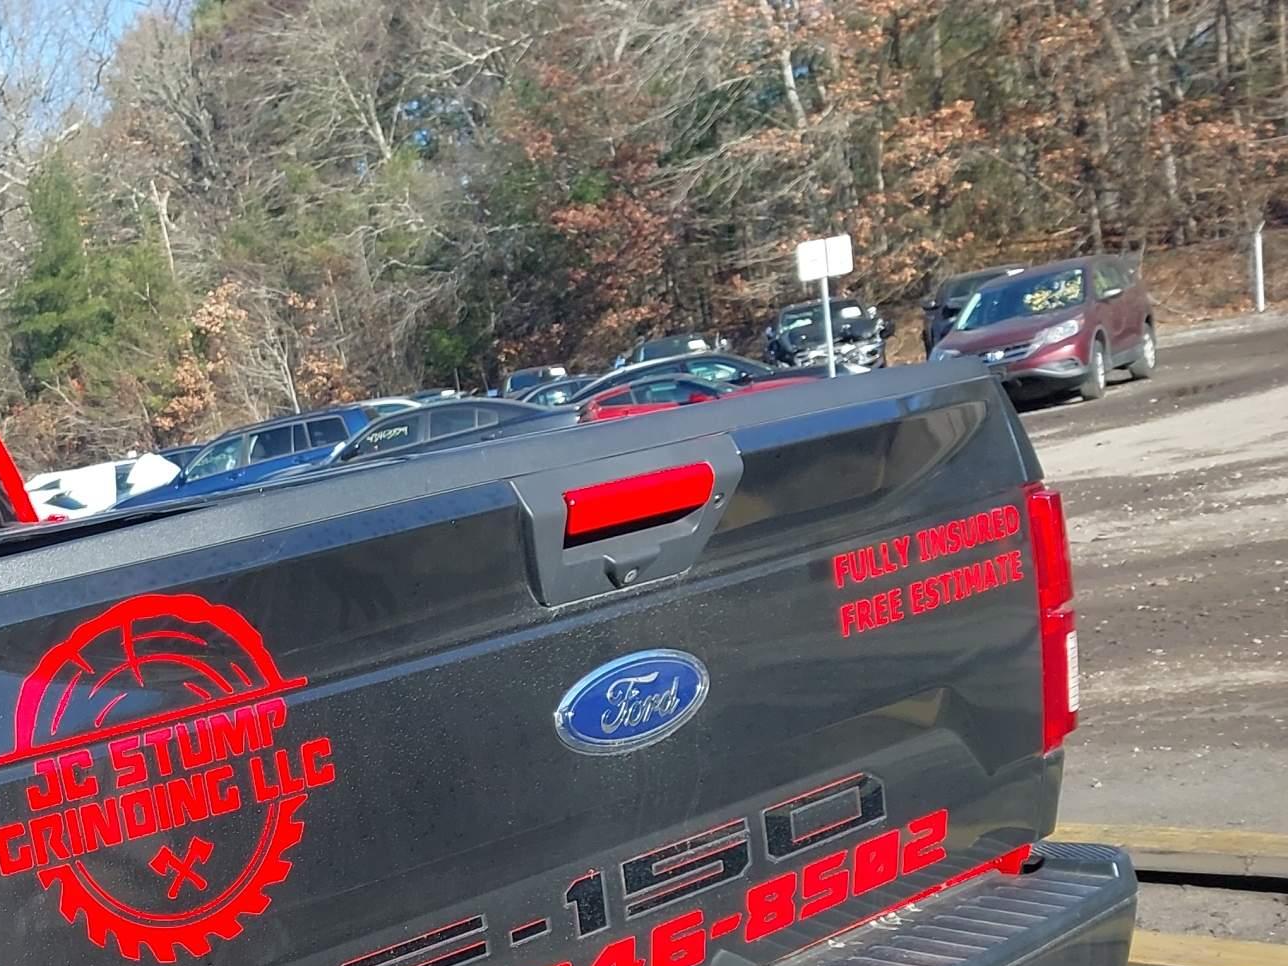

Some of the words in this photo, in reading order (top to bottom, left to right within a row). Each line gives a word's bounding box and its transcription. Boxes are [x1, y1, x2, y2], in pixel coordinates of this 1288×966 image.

[833, 535, 911, 589] FULLY
[916, 504, 1021, 562] INSURED
[839, 587, 905, 638] FREE
[910, 550, 1025, 615] ESTIMATE
[601, 671, 681, 734] Ford
[26, 749, 99, 812] JC
[108, 697, 287, 789] STUMP
[250, 737, 336, 803] LLC
